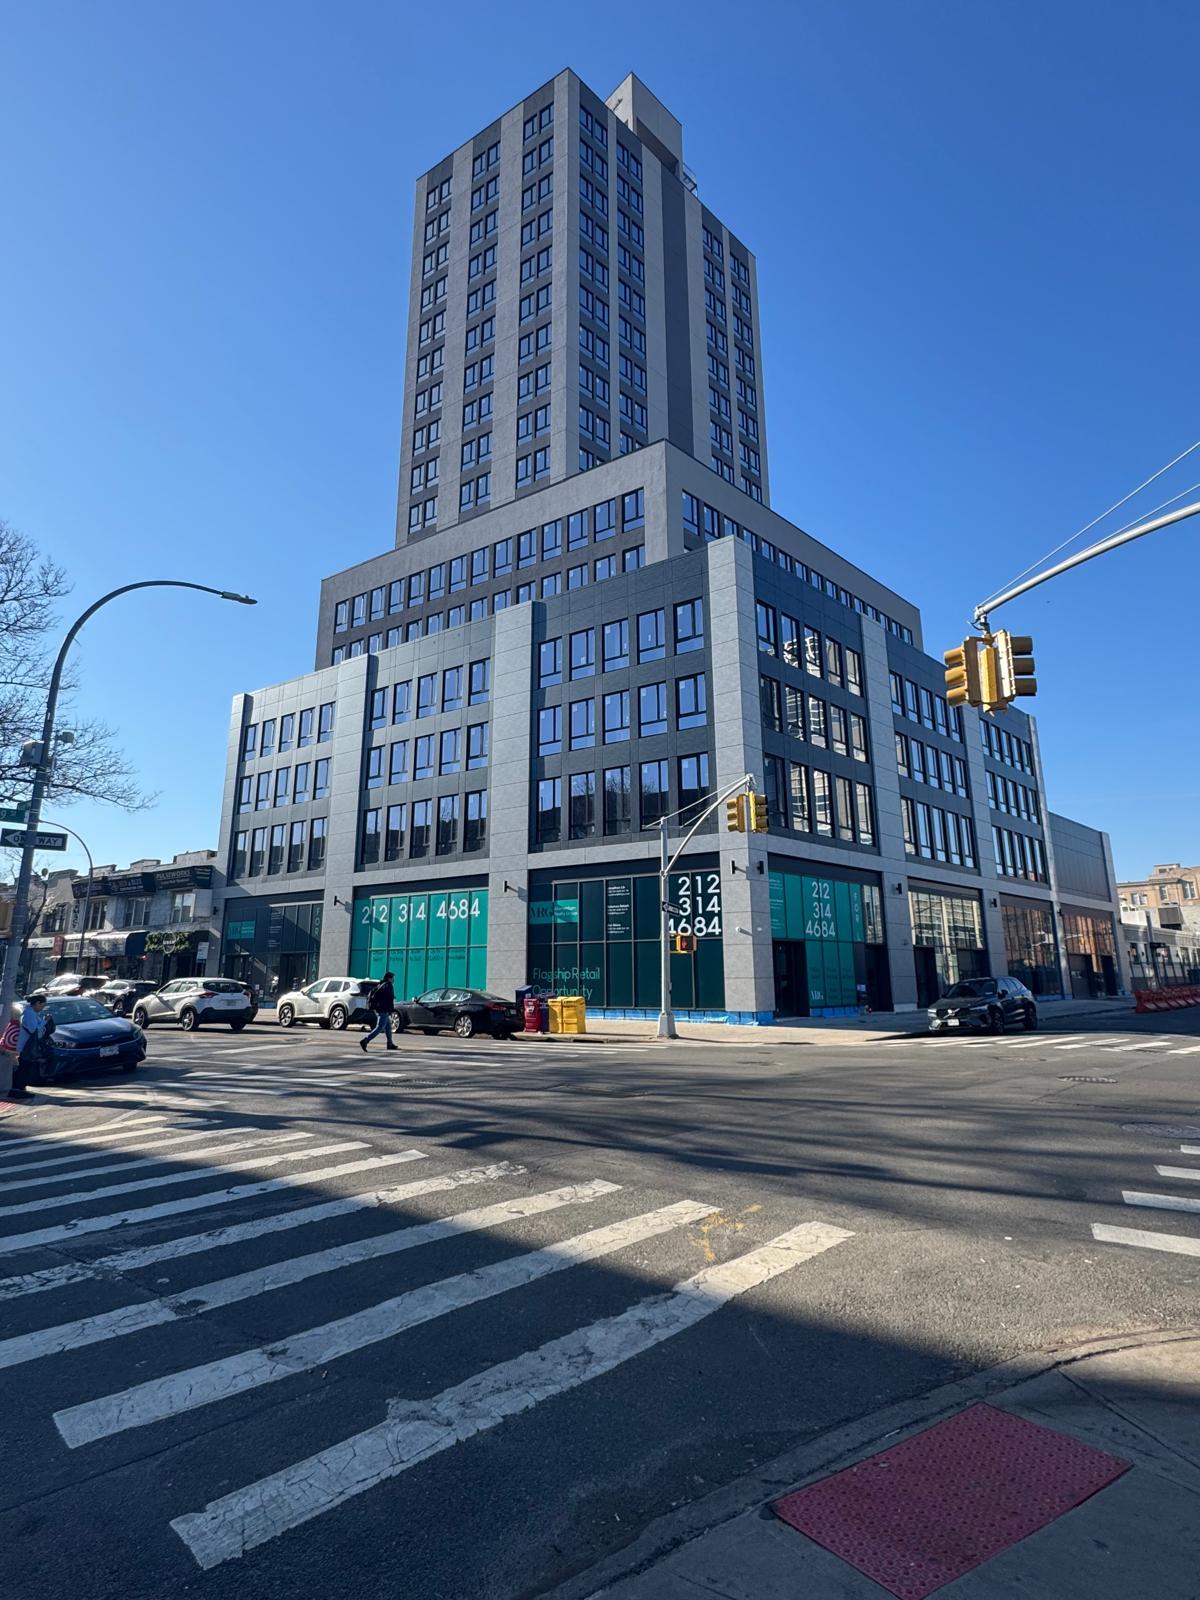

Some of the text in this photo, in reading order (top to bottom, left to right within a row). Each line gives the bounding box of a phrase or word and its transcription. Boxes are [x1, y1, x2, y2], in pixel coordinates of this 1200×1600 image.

[38, 837, 59, 846] WAY
[678, 874, 720, 896] 212
[811, 880, 830, 899] 212
[361, 898, 480, 924] 212 314 4684
[679, 895, 721, 917] 314
[812, 901, 832, 919] 314
[668, 916, 722, 938] 4684
[805, 920, 836, 938] 4684
[532, 966, 601, 982] Flagship Retail
